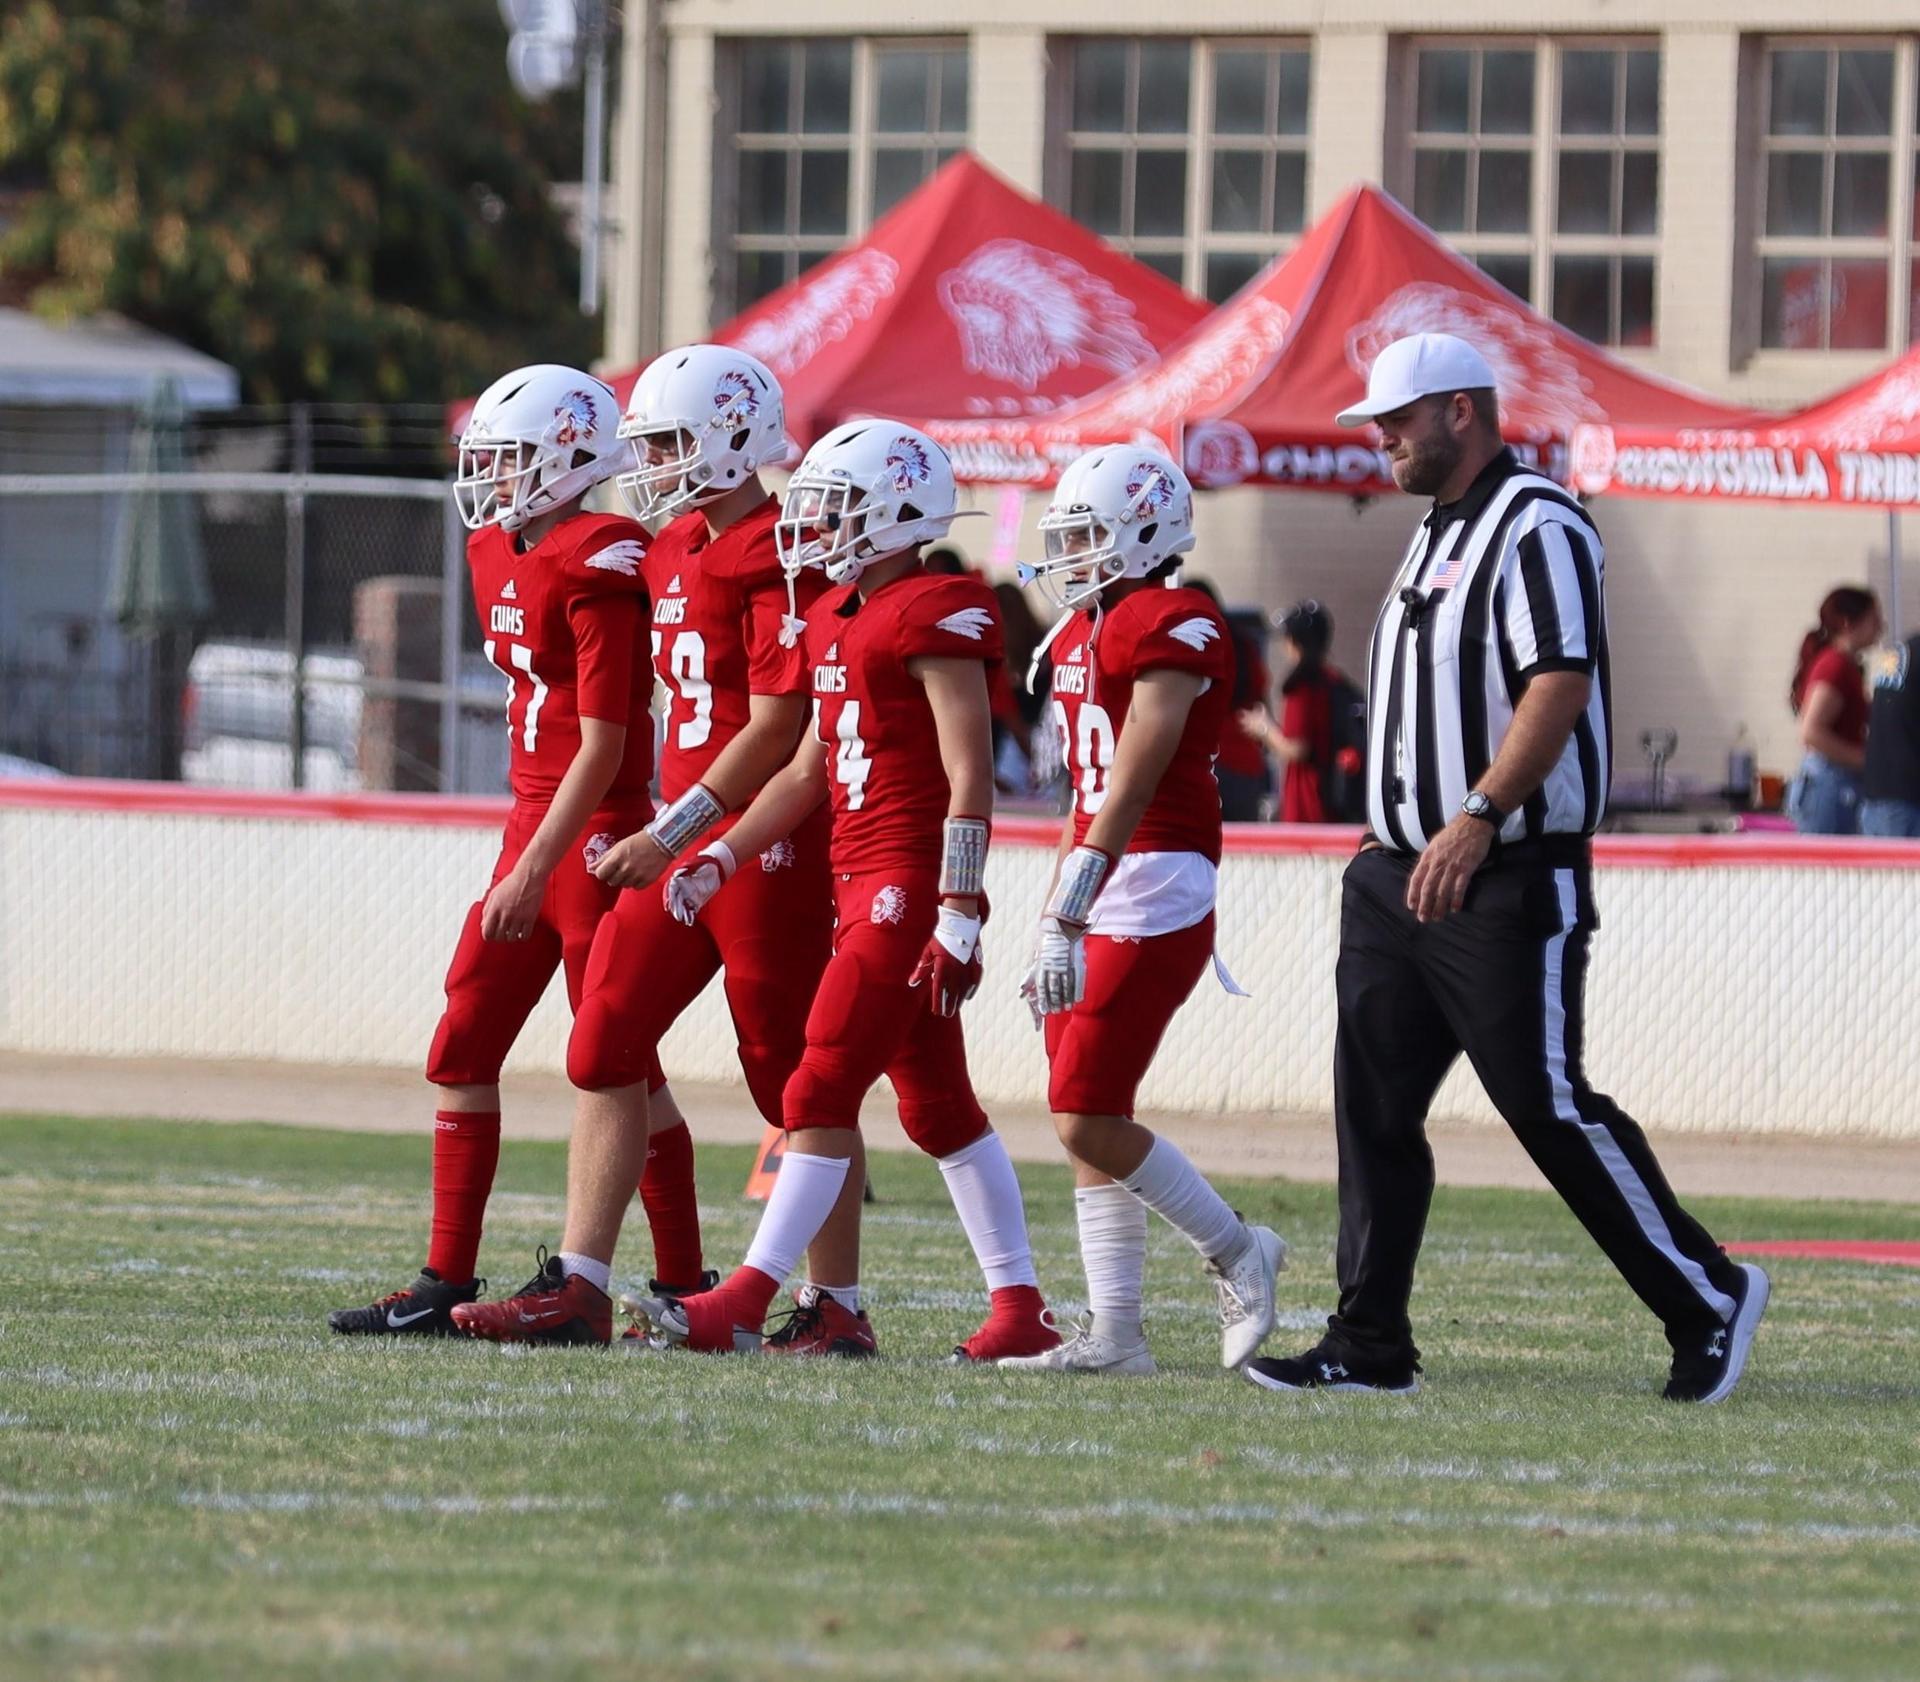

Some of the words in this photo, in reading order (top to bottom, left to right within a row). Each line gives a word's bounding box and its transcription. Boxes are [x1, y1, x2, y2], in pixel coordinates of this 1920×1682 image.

[1836, 451, 1920, 503] TRIB
[490, 604, 525, 636] CUHS
[653, 597, 688, 624] CUHS
[814, 665, 847, 693] CUHS
[1054, 664, 1087, 694] CUHS
